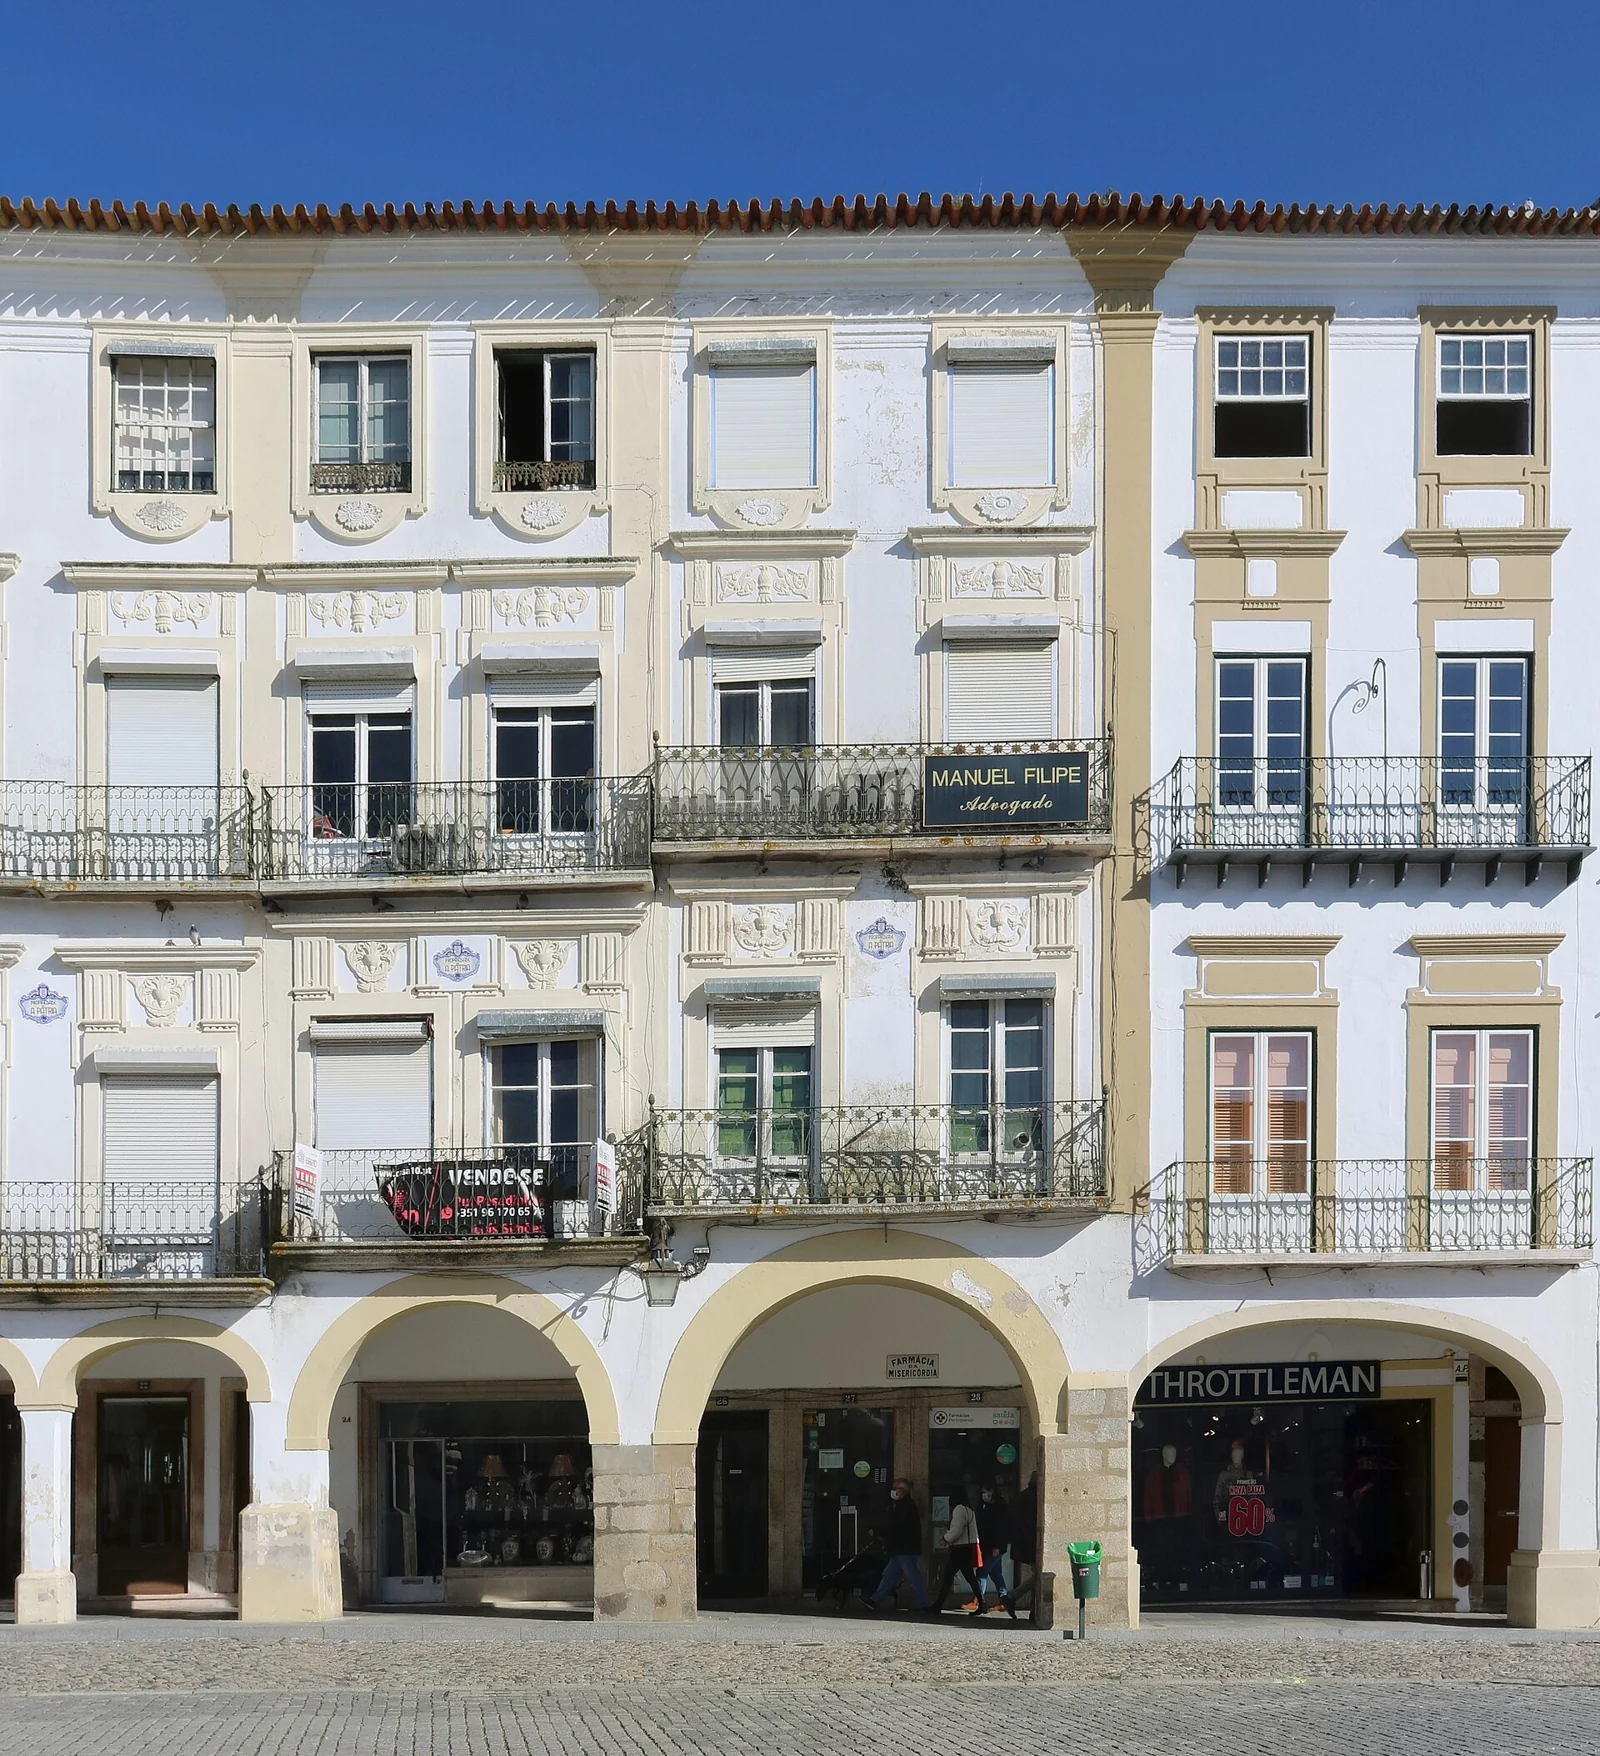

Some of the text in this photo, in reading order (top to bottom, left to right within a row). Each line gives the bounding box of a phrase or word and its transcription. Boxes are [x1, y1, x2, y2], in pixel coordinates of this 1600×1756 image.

[932, 766, 1081, 787] MANUEL FILIPE
[959, 794, 1054, 815] Advogado
[481, 1207, 494, 1217] 96
[497, 1207, 515, 1217] 170
[517, 1206, 530, 1216] 65
[891, 1355, 935, 1368] FARMÁCIA
[1149, 1365, 1375, 1399] THROTTLEMAN
[845, 1394, 856, 1402] 27
